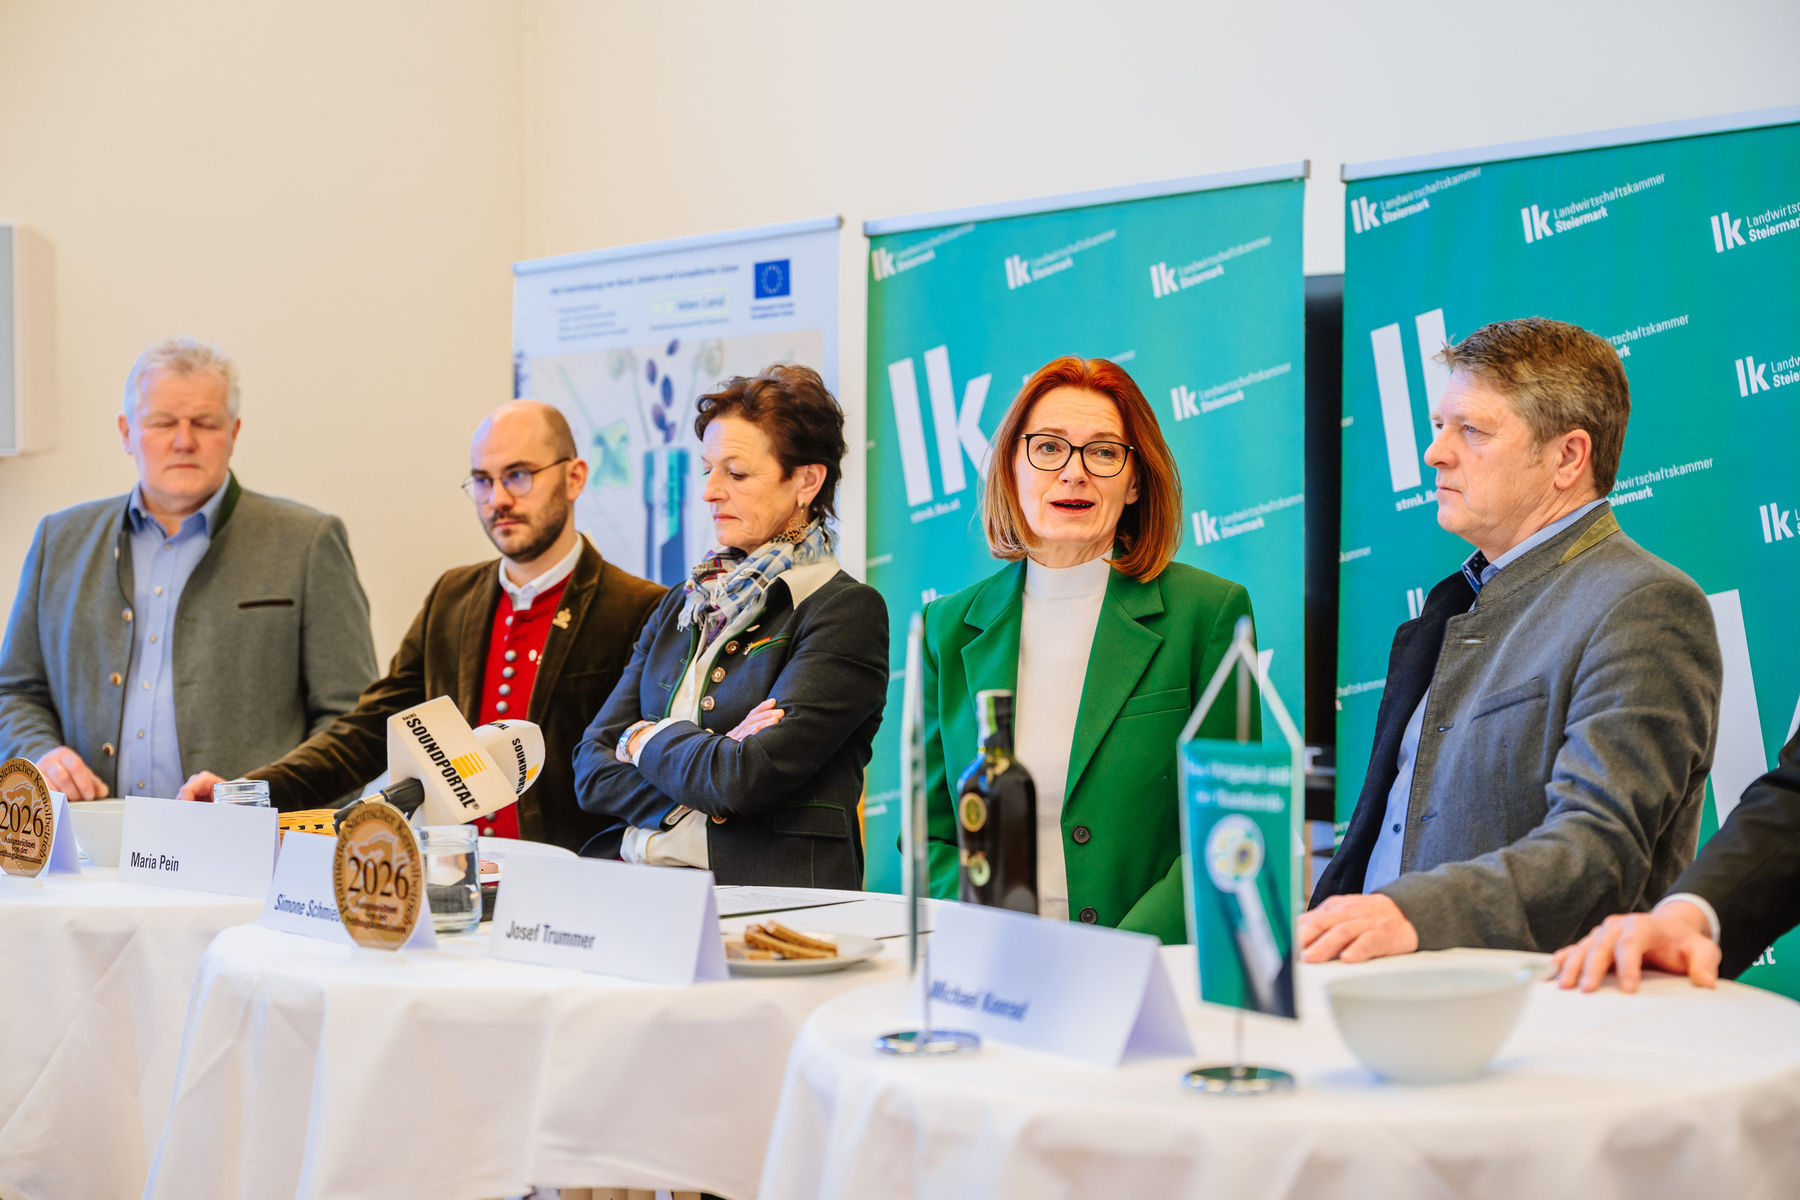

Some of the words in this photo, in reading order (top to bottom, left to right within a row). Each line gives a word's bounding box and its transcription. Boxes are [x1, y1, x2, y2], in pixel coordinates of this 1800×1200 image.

[1350, 196, 1381, 234] lk
[1553, 173, 1665, 220] Landwirtschaftskammer
[1521, 204, 1553, 244] lk
[1555, 204, 1609, 233] Steiermark
[1710, 211, 1747, 253] lk
[1748, 214, 1800, 242] Steiermar
[1735, 356, 1770, 398] lk
[888, 344, 998, 507] lk
[1612, 457, 1715, 493] dwirtschaftskammer
[1759, 502, 1795, 544] lk
[130, 851, 157, 870] Maria
[159, 854, 180, 872] Pein
[348, 855, 410, 901] 2026
[506, 920, 541, 942] Josef
[542, 924, 596, 950] Trummer
